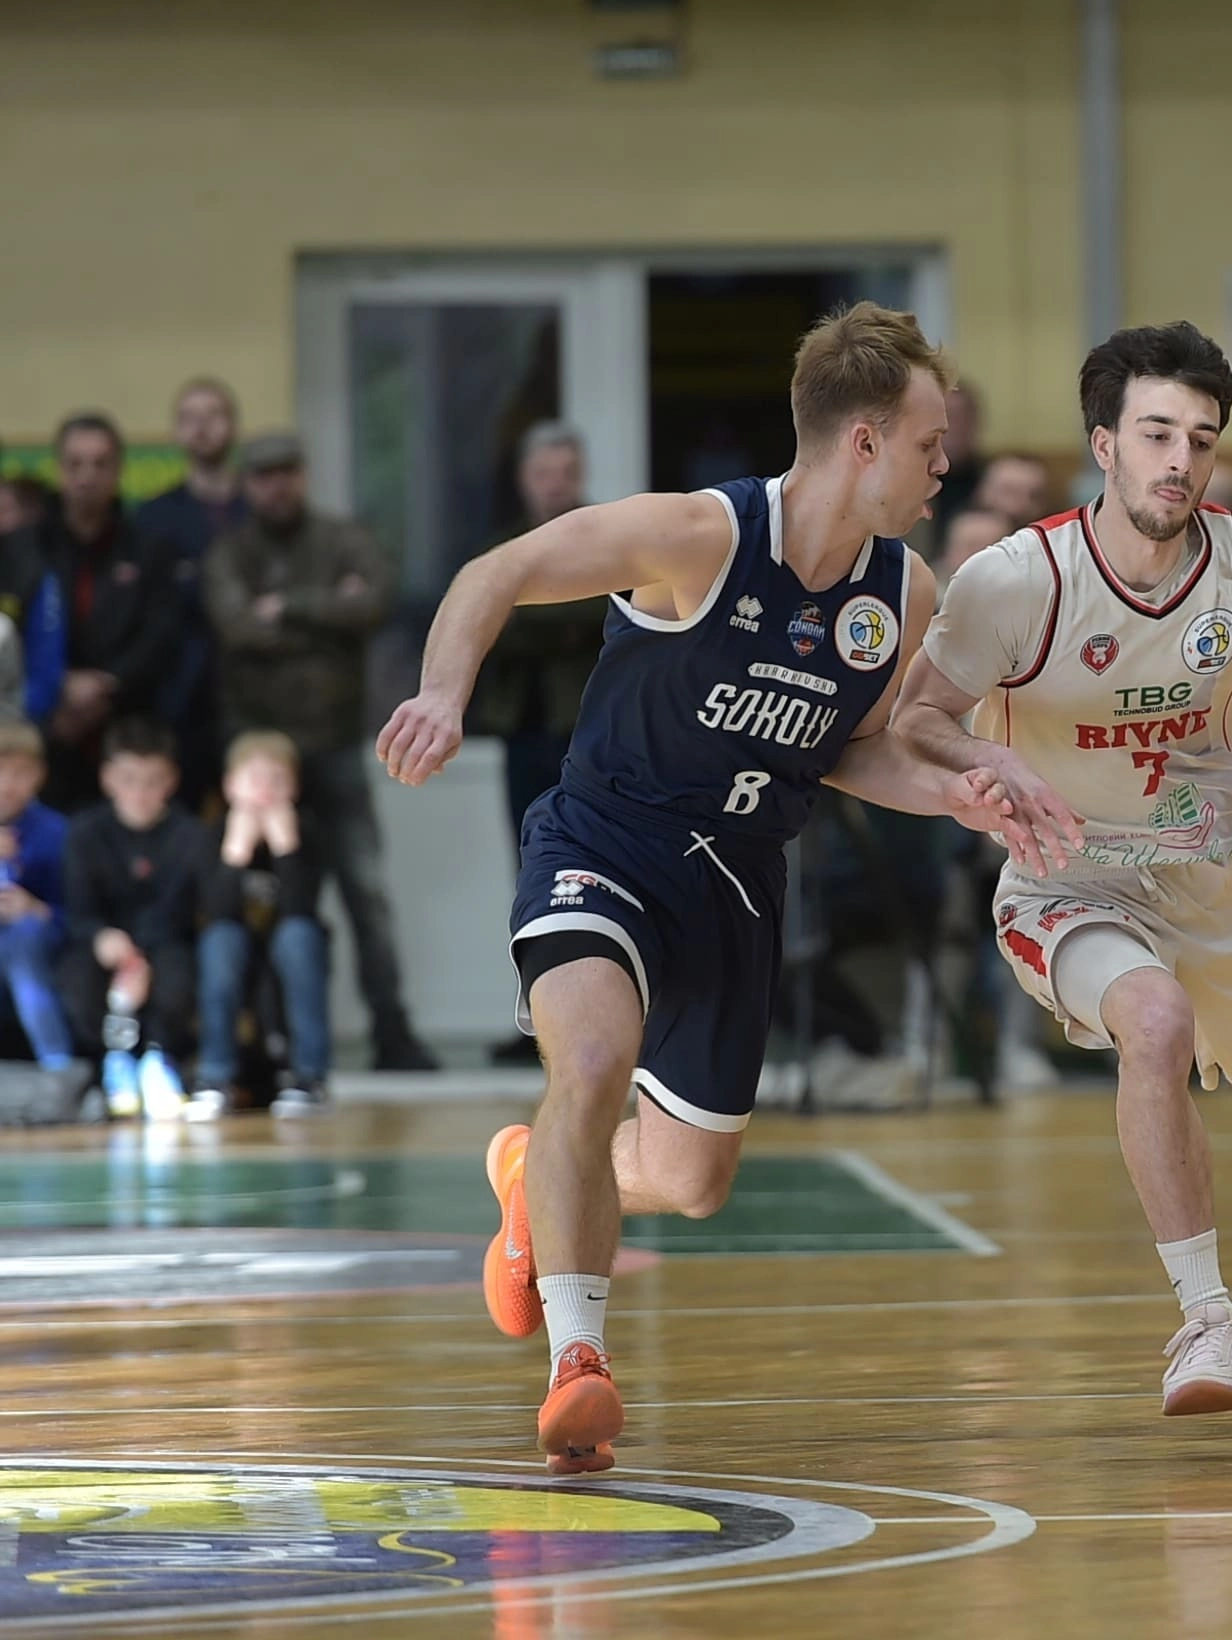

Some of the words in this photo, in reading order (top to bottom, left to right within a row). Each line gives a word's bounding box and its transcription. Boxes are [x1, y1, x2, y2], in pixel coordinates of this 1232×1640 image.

[697, 683, 838, 749] SOKOLY
[1113, 705, 1164, 717] TECHNOBUD
[1164, 701, 1192, 712] GROUP
[1114, 682, 1193, 709] TBG
[723, 771, 771, 814] 8
[1131, 751, 1170, 797] 7
